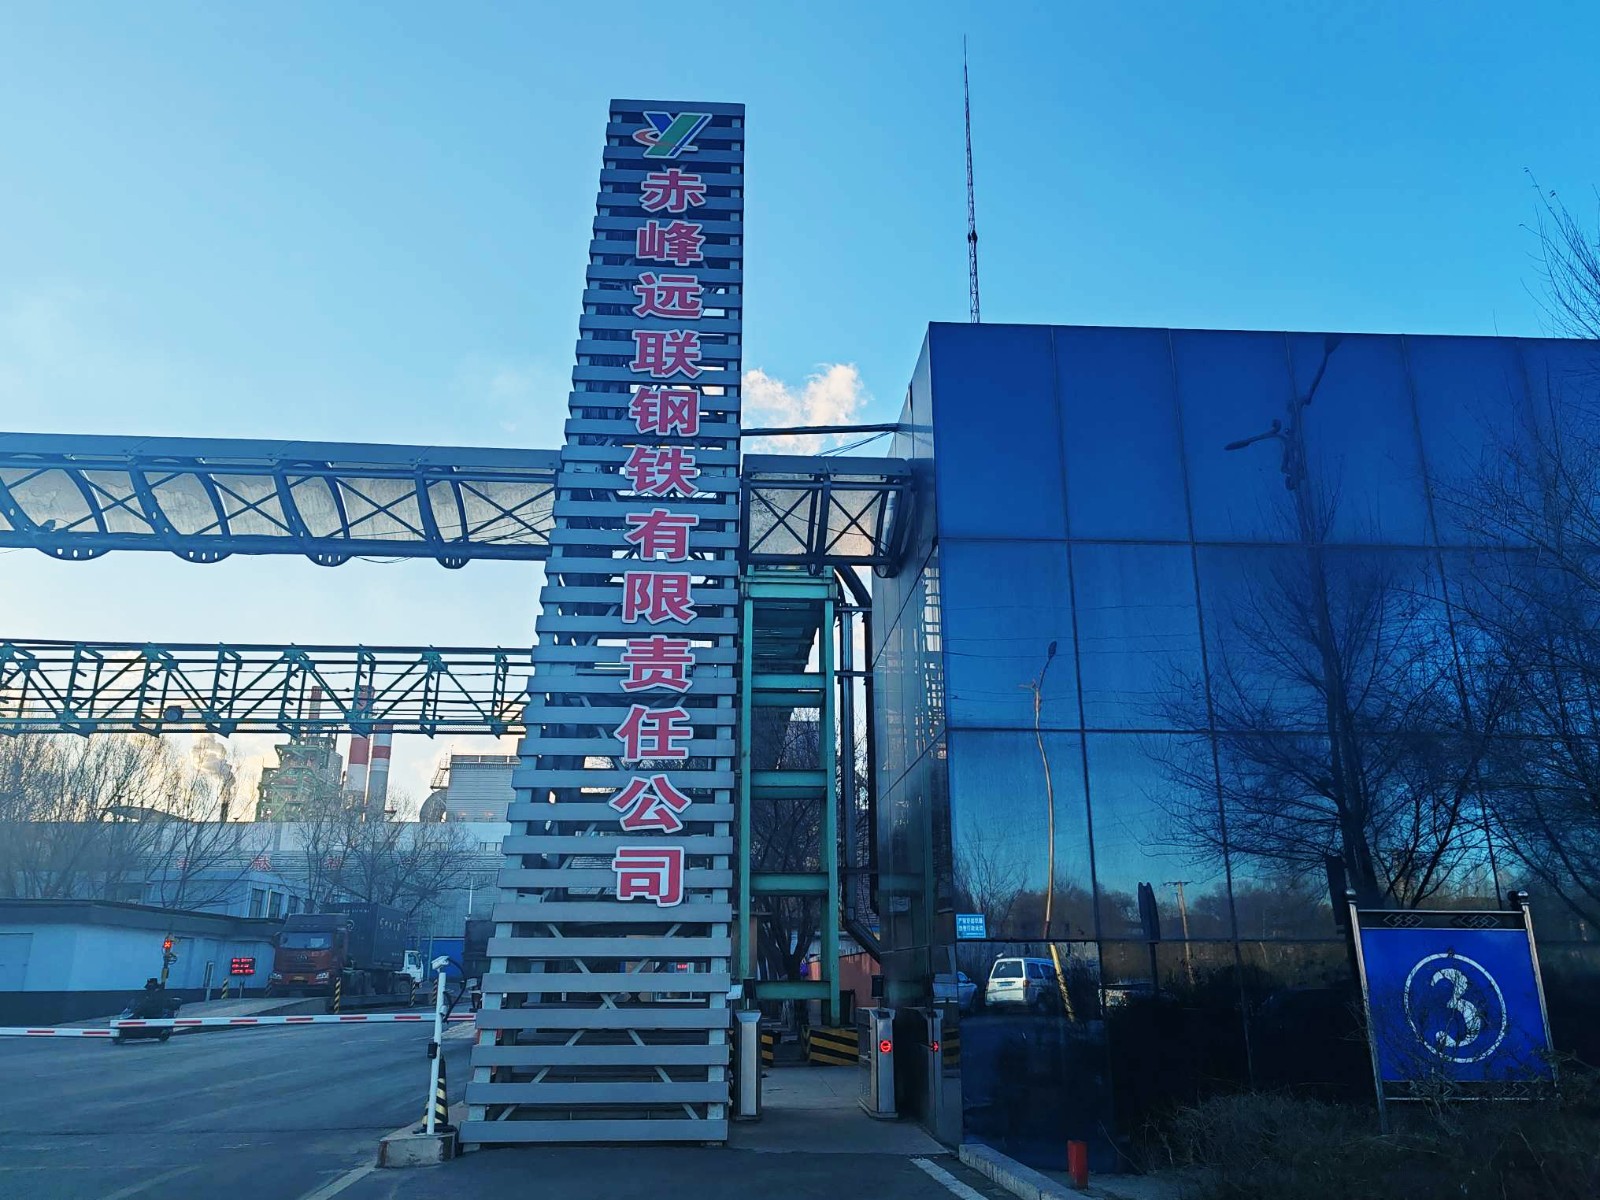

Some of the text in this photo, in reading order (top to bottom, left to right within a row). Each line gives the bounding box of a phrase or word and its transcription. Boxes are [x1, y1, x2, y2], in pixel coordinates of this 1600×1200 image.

[609, 168, 706, 907] 赤峰远联钢铁有限责任公司
[1430, 968, 1481, 1047] 3
